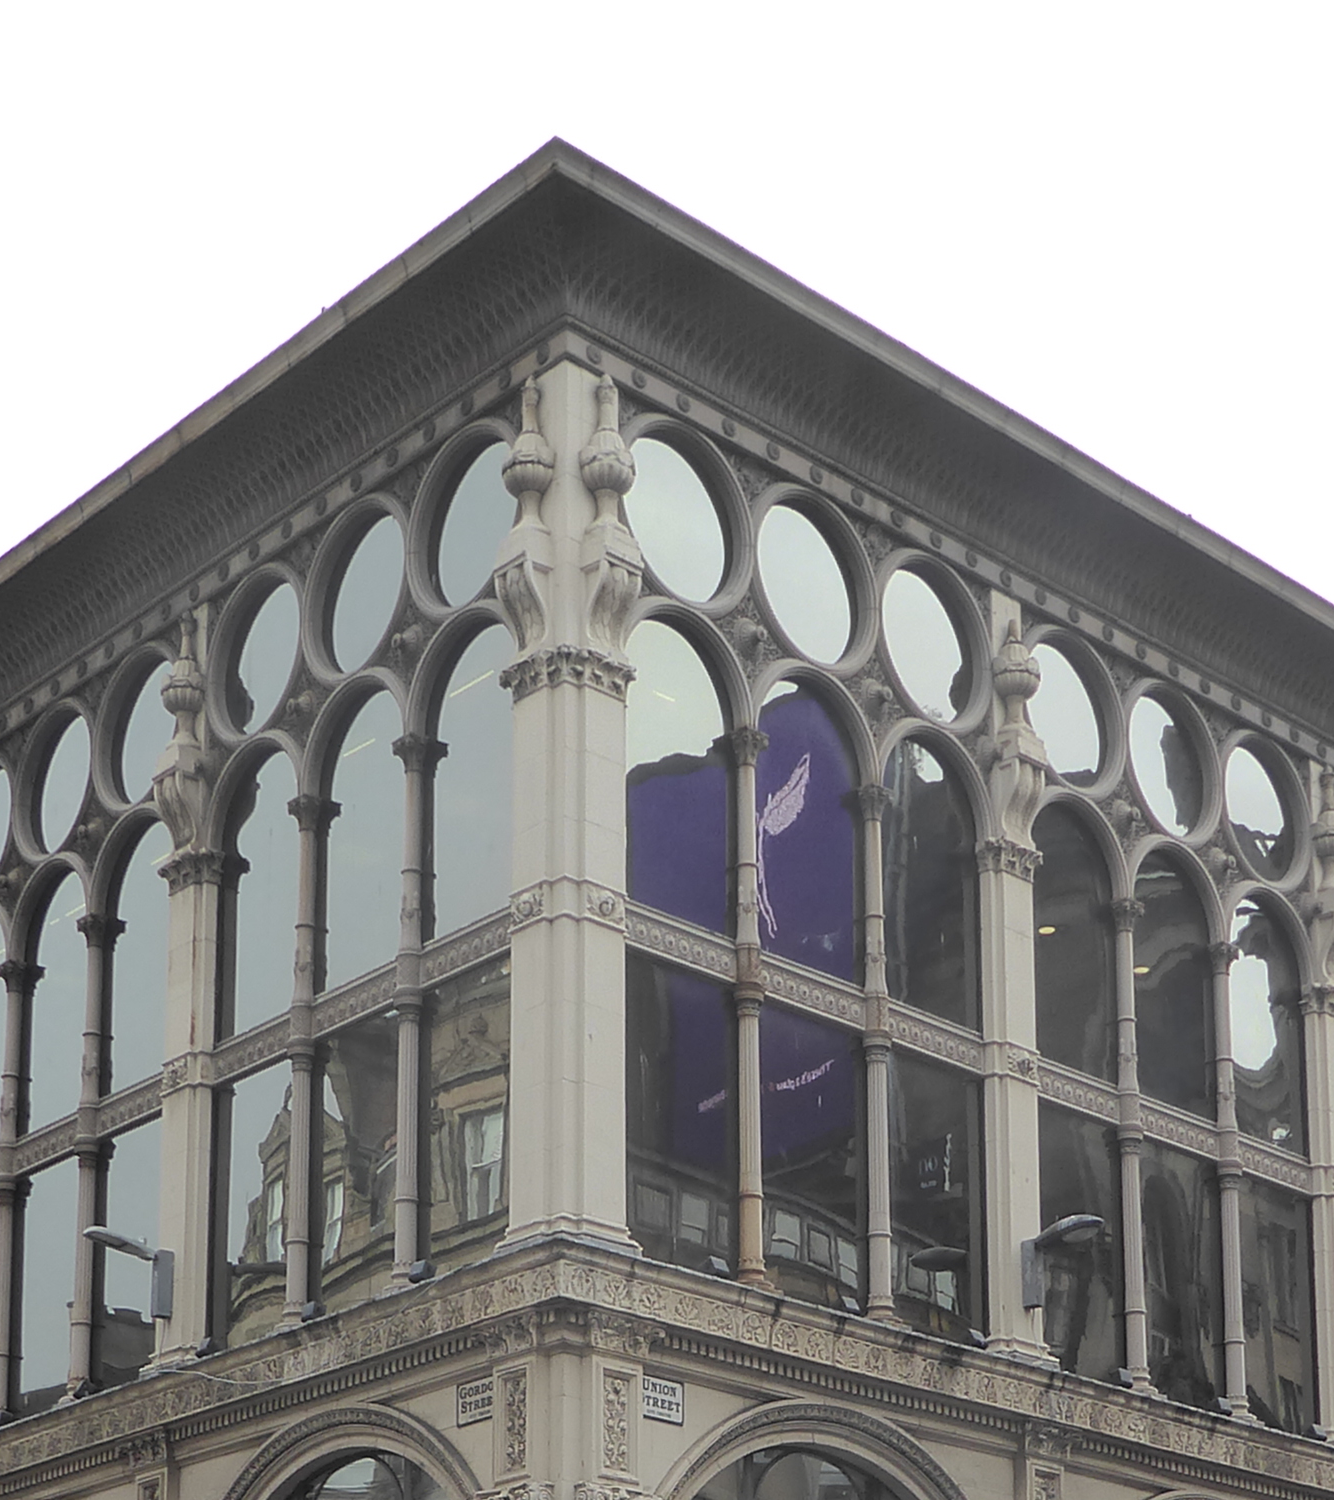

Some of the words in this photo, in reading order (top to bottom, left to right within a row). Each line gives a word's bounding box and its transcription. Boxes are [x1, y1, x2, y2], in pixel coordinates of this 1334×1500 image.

[459, 1381, 493, 1400] GORDO
[643, 1378, 677, 1398] UNION
[461, 1395, 493, 1414] STREE
